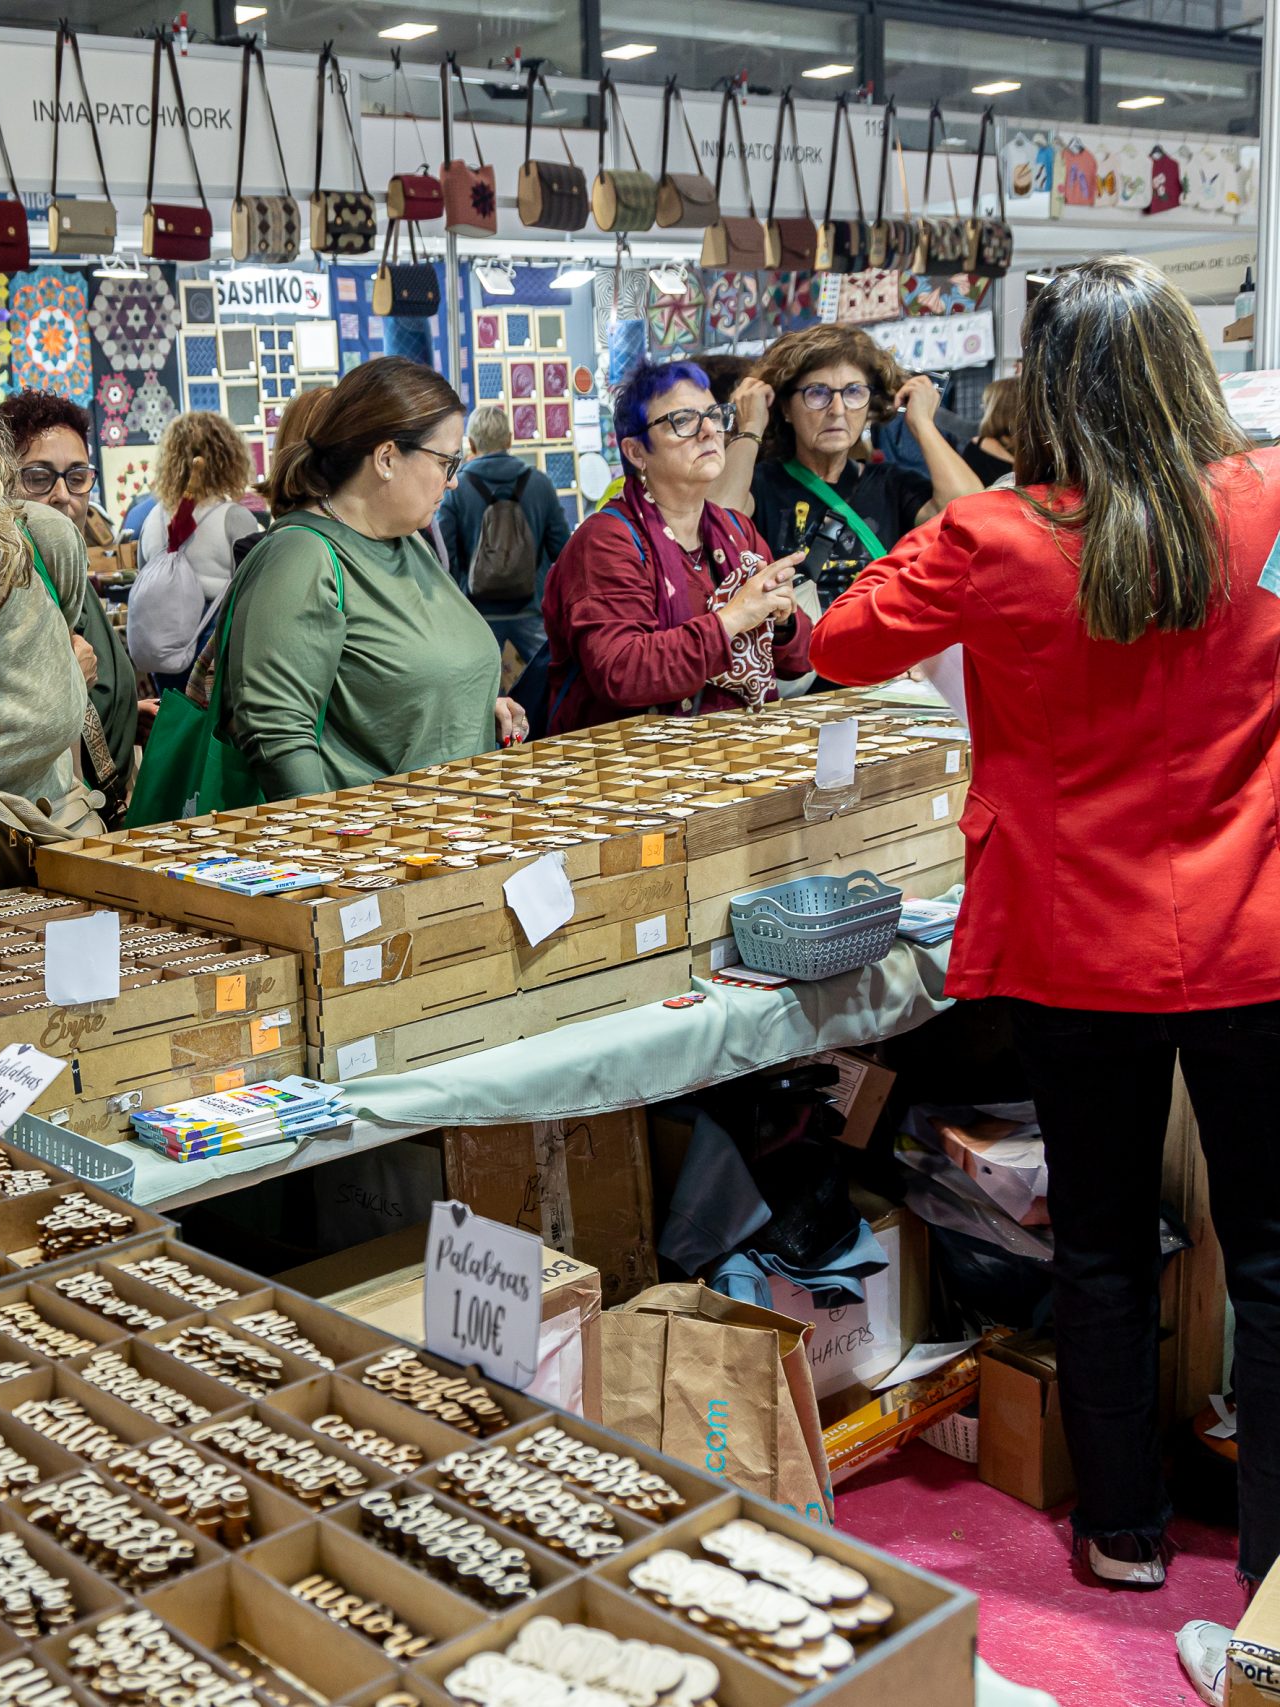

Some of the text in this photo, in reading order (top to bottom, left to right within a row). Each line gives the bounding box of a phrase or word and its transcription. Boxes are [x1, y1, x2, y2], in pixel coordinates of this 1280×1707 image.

[32, 99, 233, 130] INMA PATCHWORK
[740, 141, 823, 163] PATCWORK
[215, 276, 303, 305] SASHIKO
[1227, 253, 1251, 266] LOS
[336, 1183, 403, 1218] STENCILS
[435, 1234, 532, 1303] Palabras
[451, 1288, 507, 1357] 1,00€
[380, 1348, 495, 1414] Bendita
[705, 1398, 730, 1480] .com
[109, 1448, 228, 1512] playa
[469, 1447, 610, 1523] Amigas
[350, 1490, 543, 1598] costureras
[401, 1493, 523, 1566] Amigas
